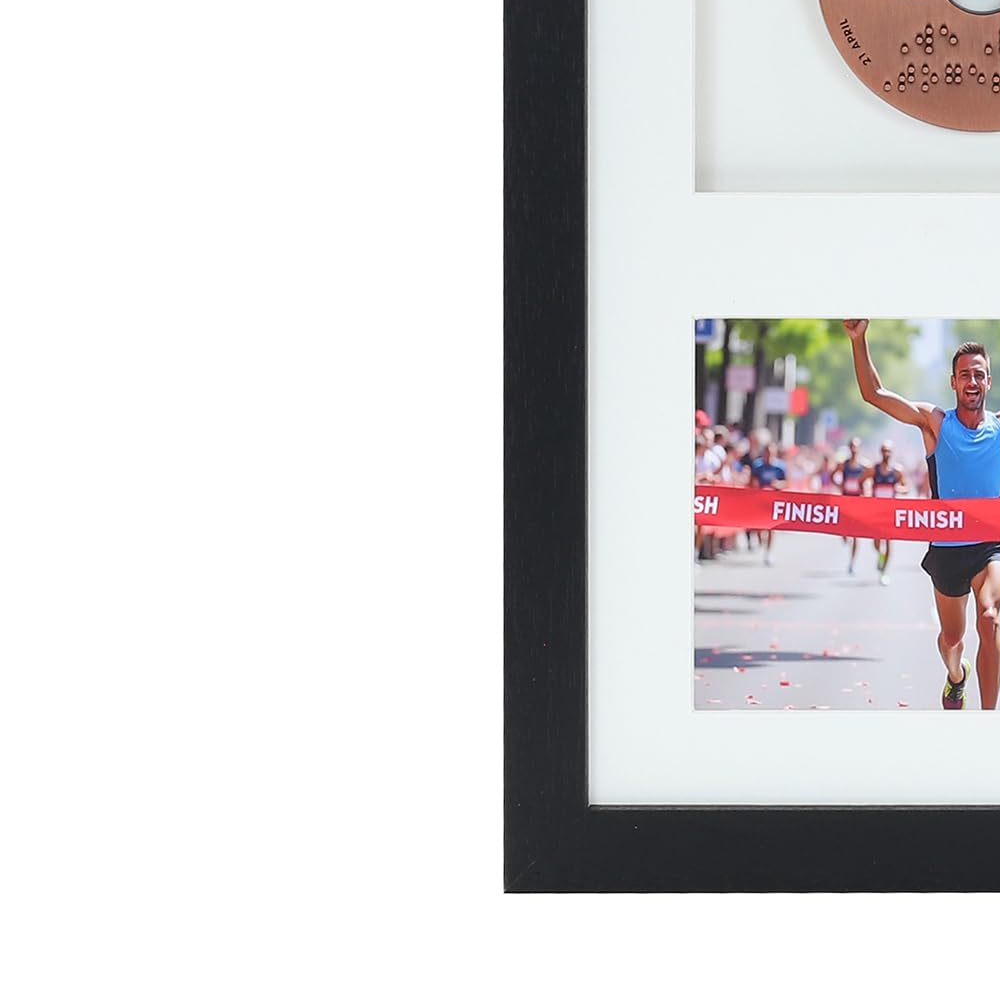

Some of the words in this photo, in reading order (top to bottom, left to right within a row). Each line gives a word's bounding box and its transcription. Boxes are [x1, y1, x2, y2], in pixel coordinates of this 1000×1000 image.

[840, 18, 861, 49] APRIL
[858, 53, 872, 66] 21
[772, 501, 839, 524] FINISH
[895, 509, 964, 529] FINISH
